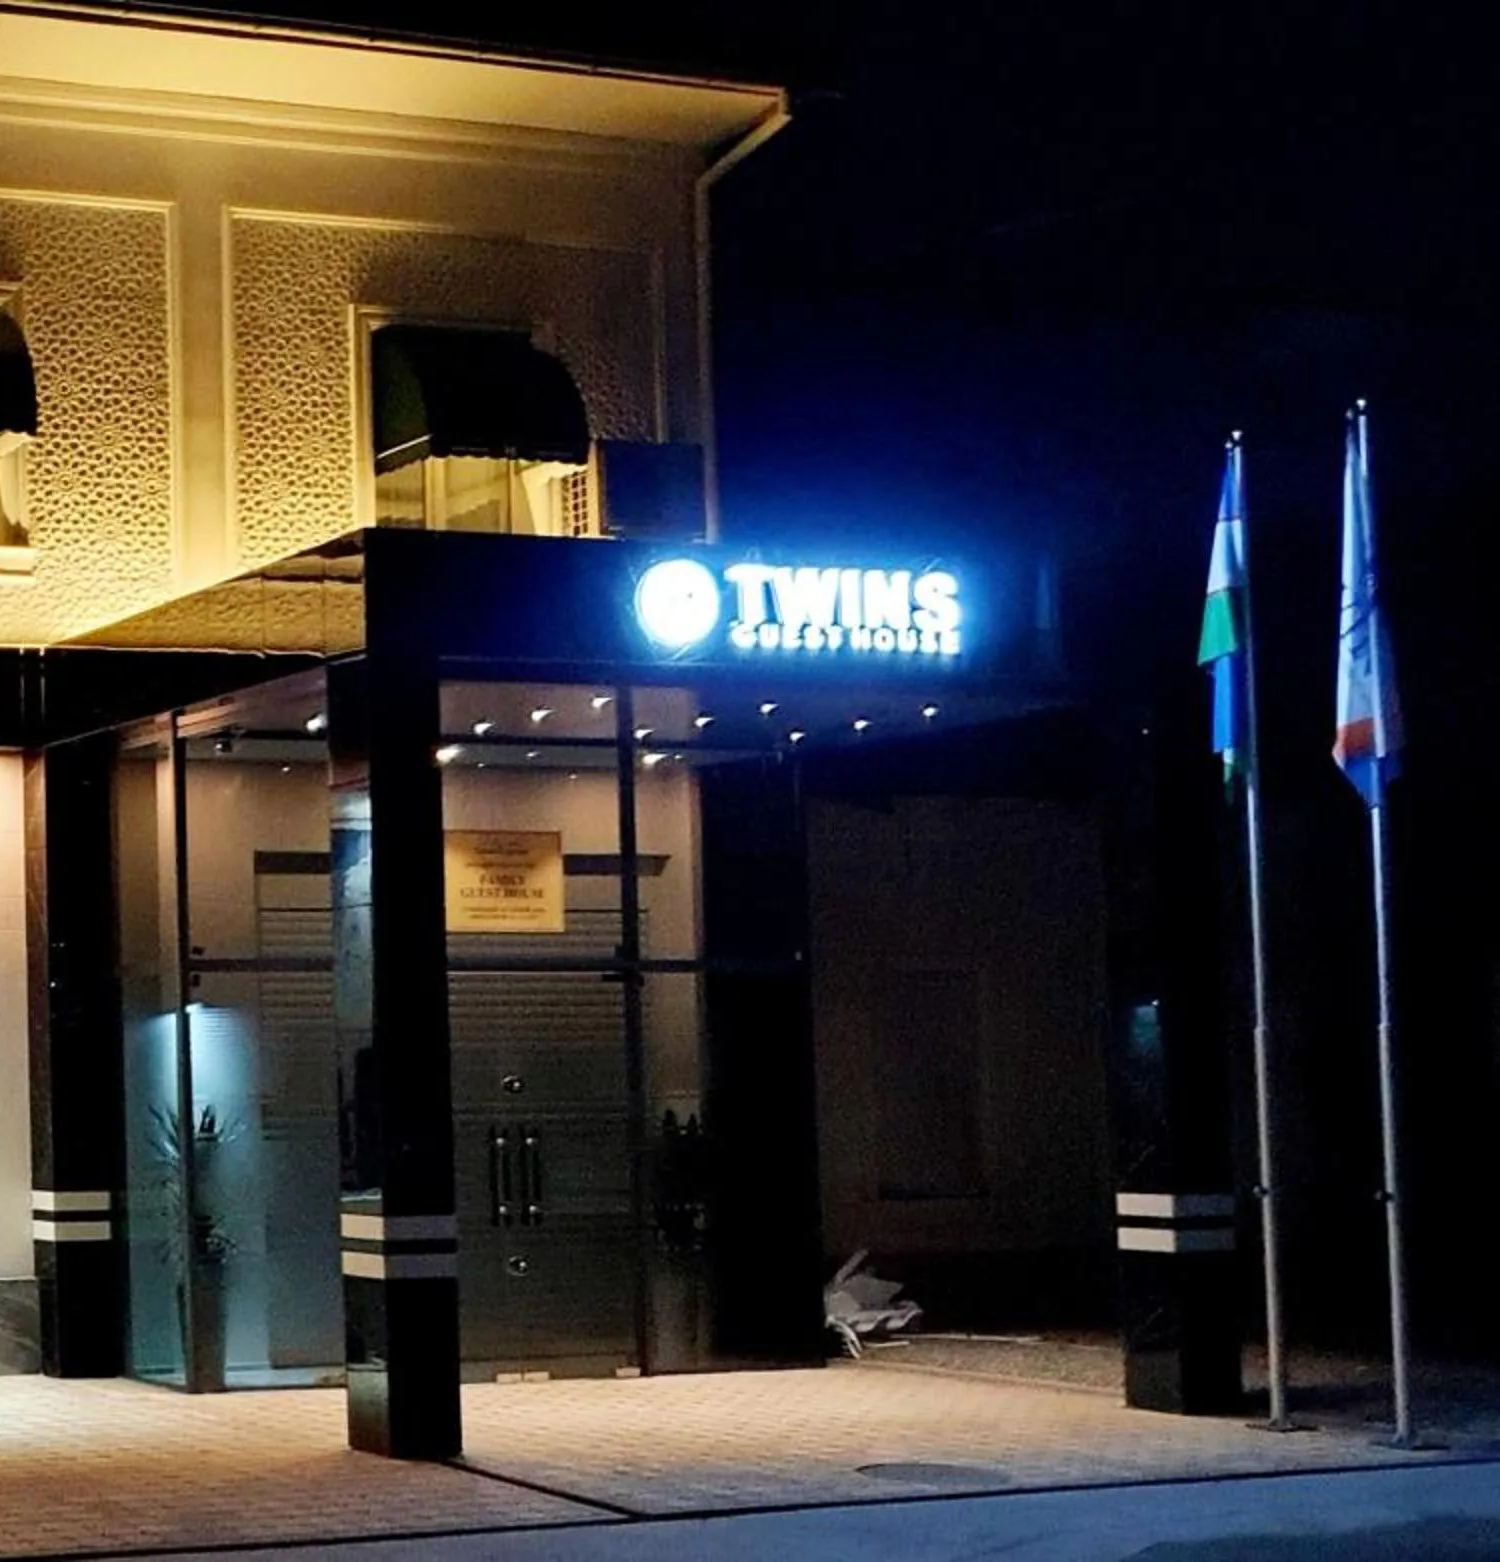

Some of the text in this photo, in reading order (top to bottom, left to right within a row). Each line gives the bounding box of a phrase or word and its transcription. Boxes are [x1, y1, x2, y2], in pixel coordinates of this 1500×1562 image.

[724, 563, 961, 630] TWINS
[730, 623, 961, 655] GUEST HOUSE
